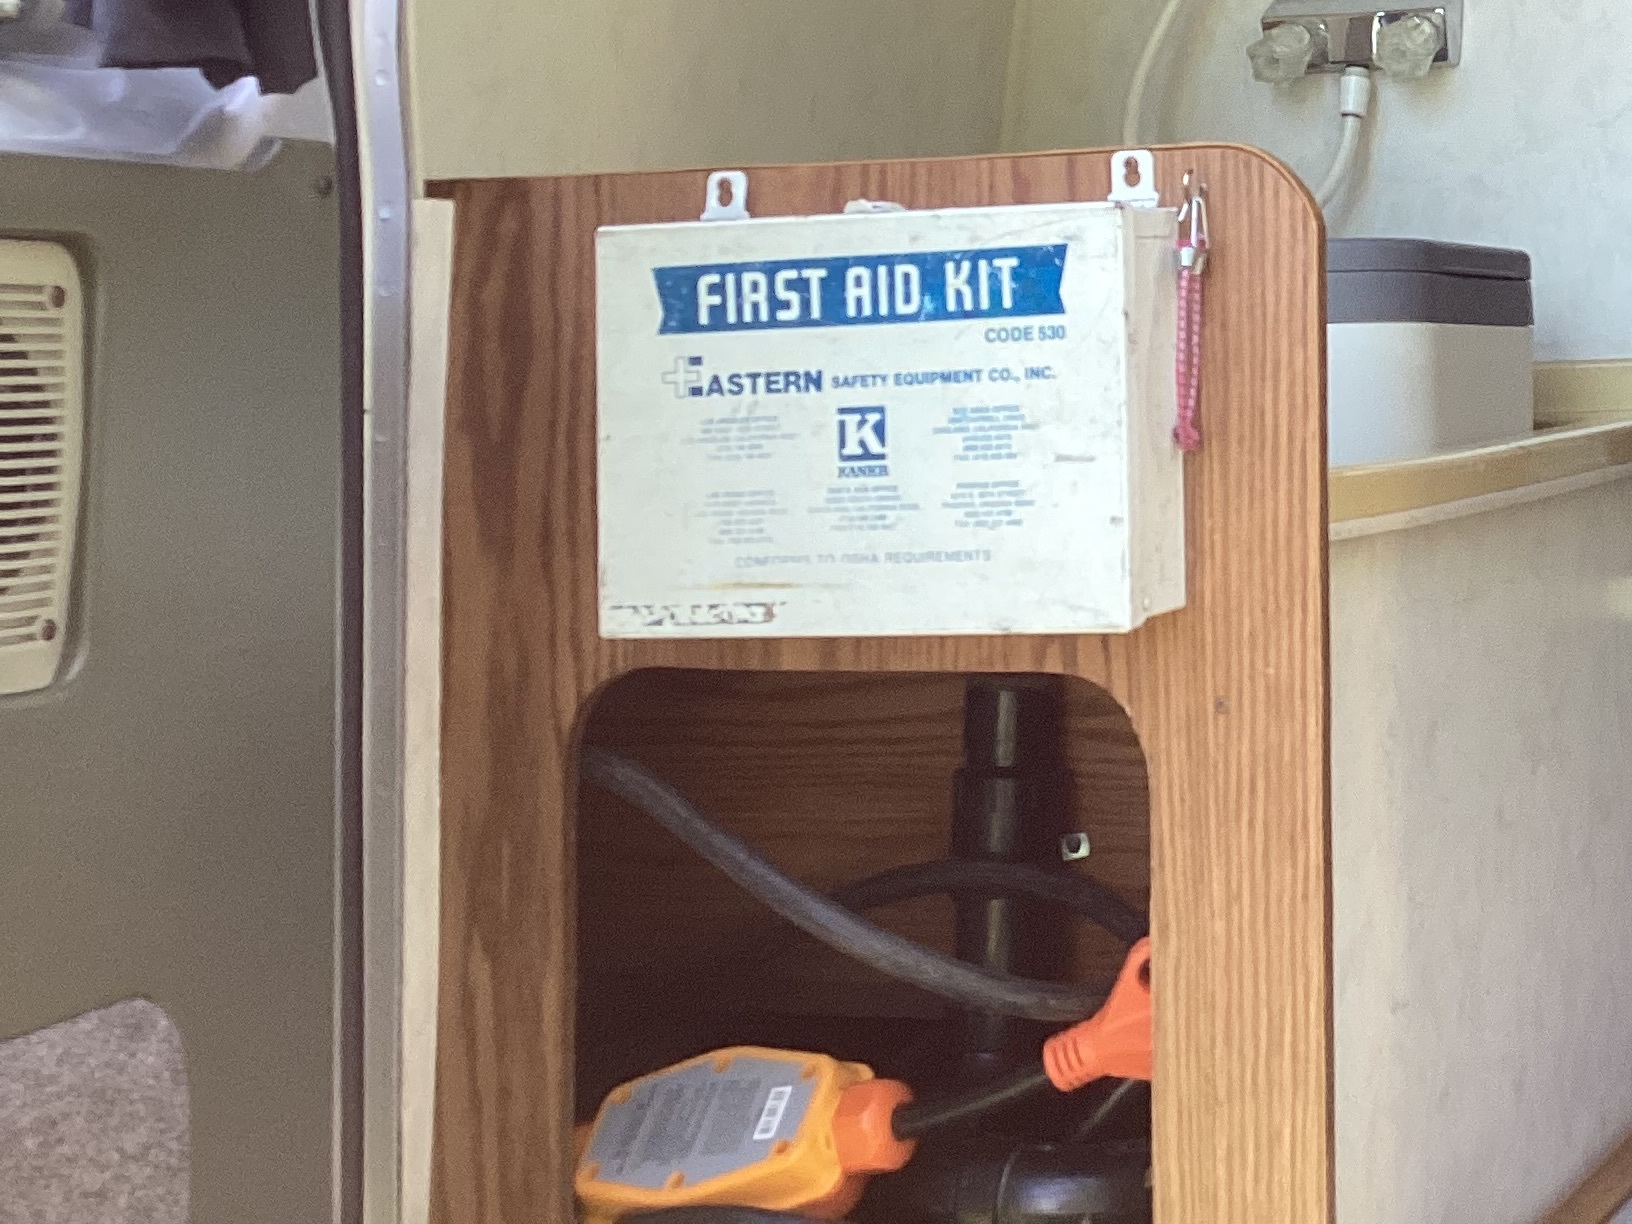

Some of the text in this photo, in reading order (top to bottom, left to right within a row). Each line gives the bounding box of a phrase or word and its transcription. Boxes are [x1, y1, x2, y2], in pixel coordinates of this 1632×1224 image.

[697, 256, 1021, 326] FIRST AID KIT
[984, 326, 1034, 343] CODE
[832, 374, 888, 389] SAFETY
[893, 368, 983, 386] EQUIPMENT
[836, 411, 889, 457] K
